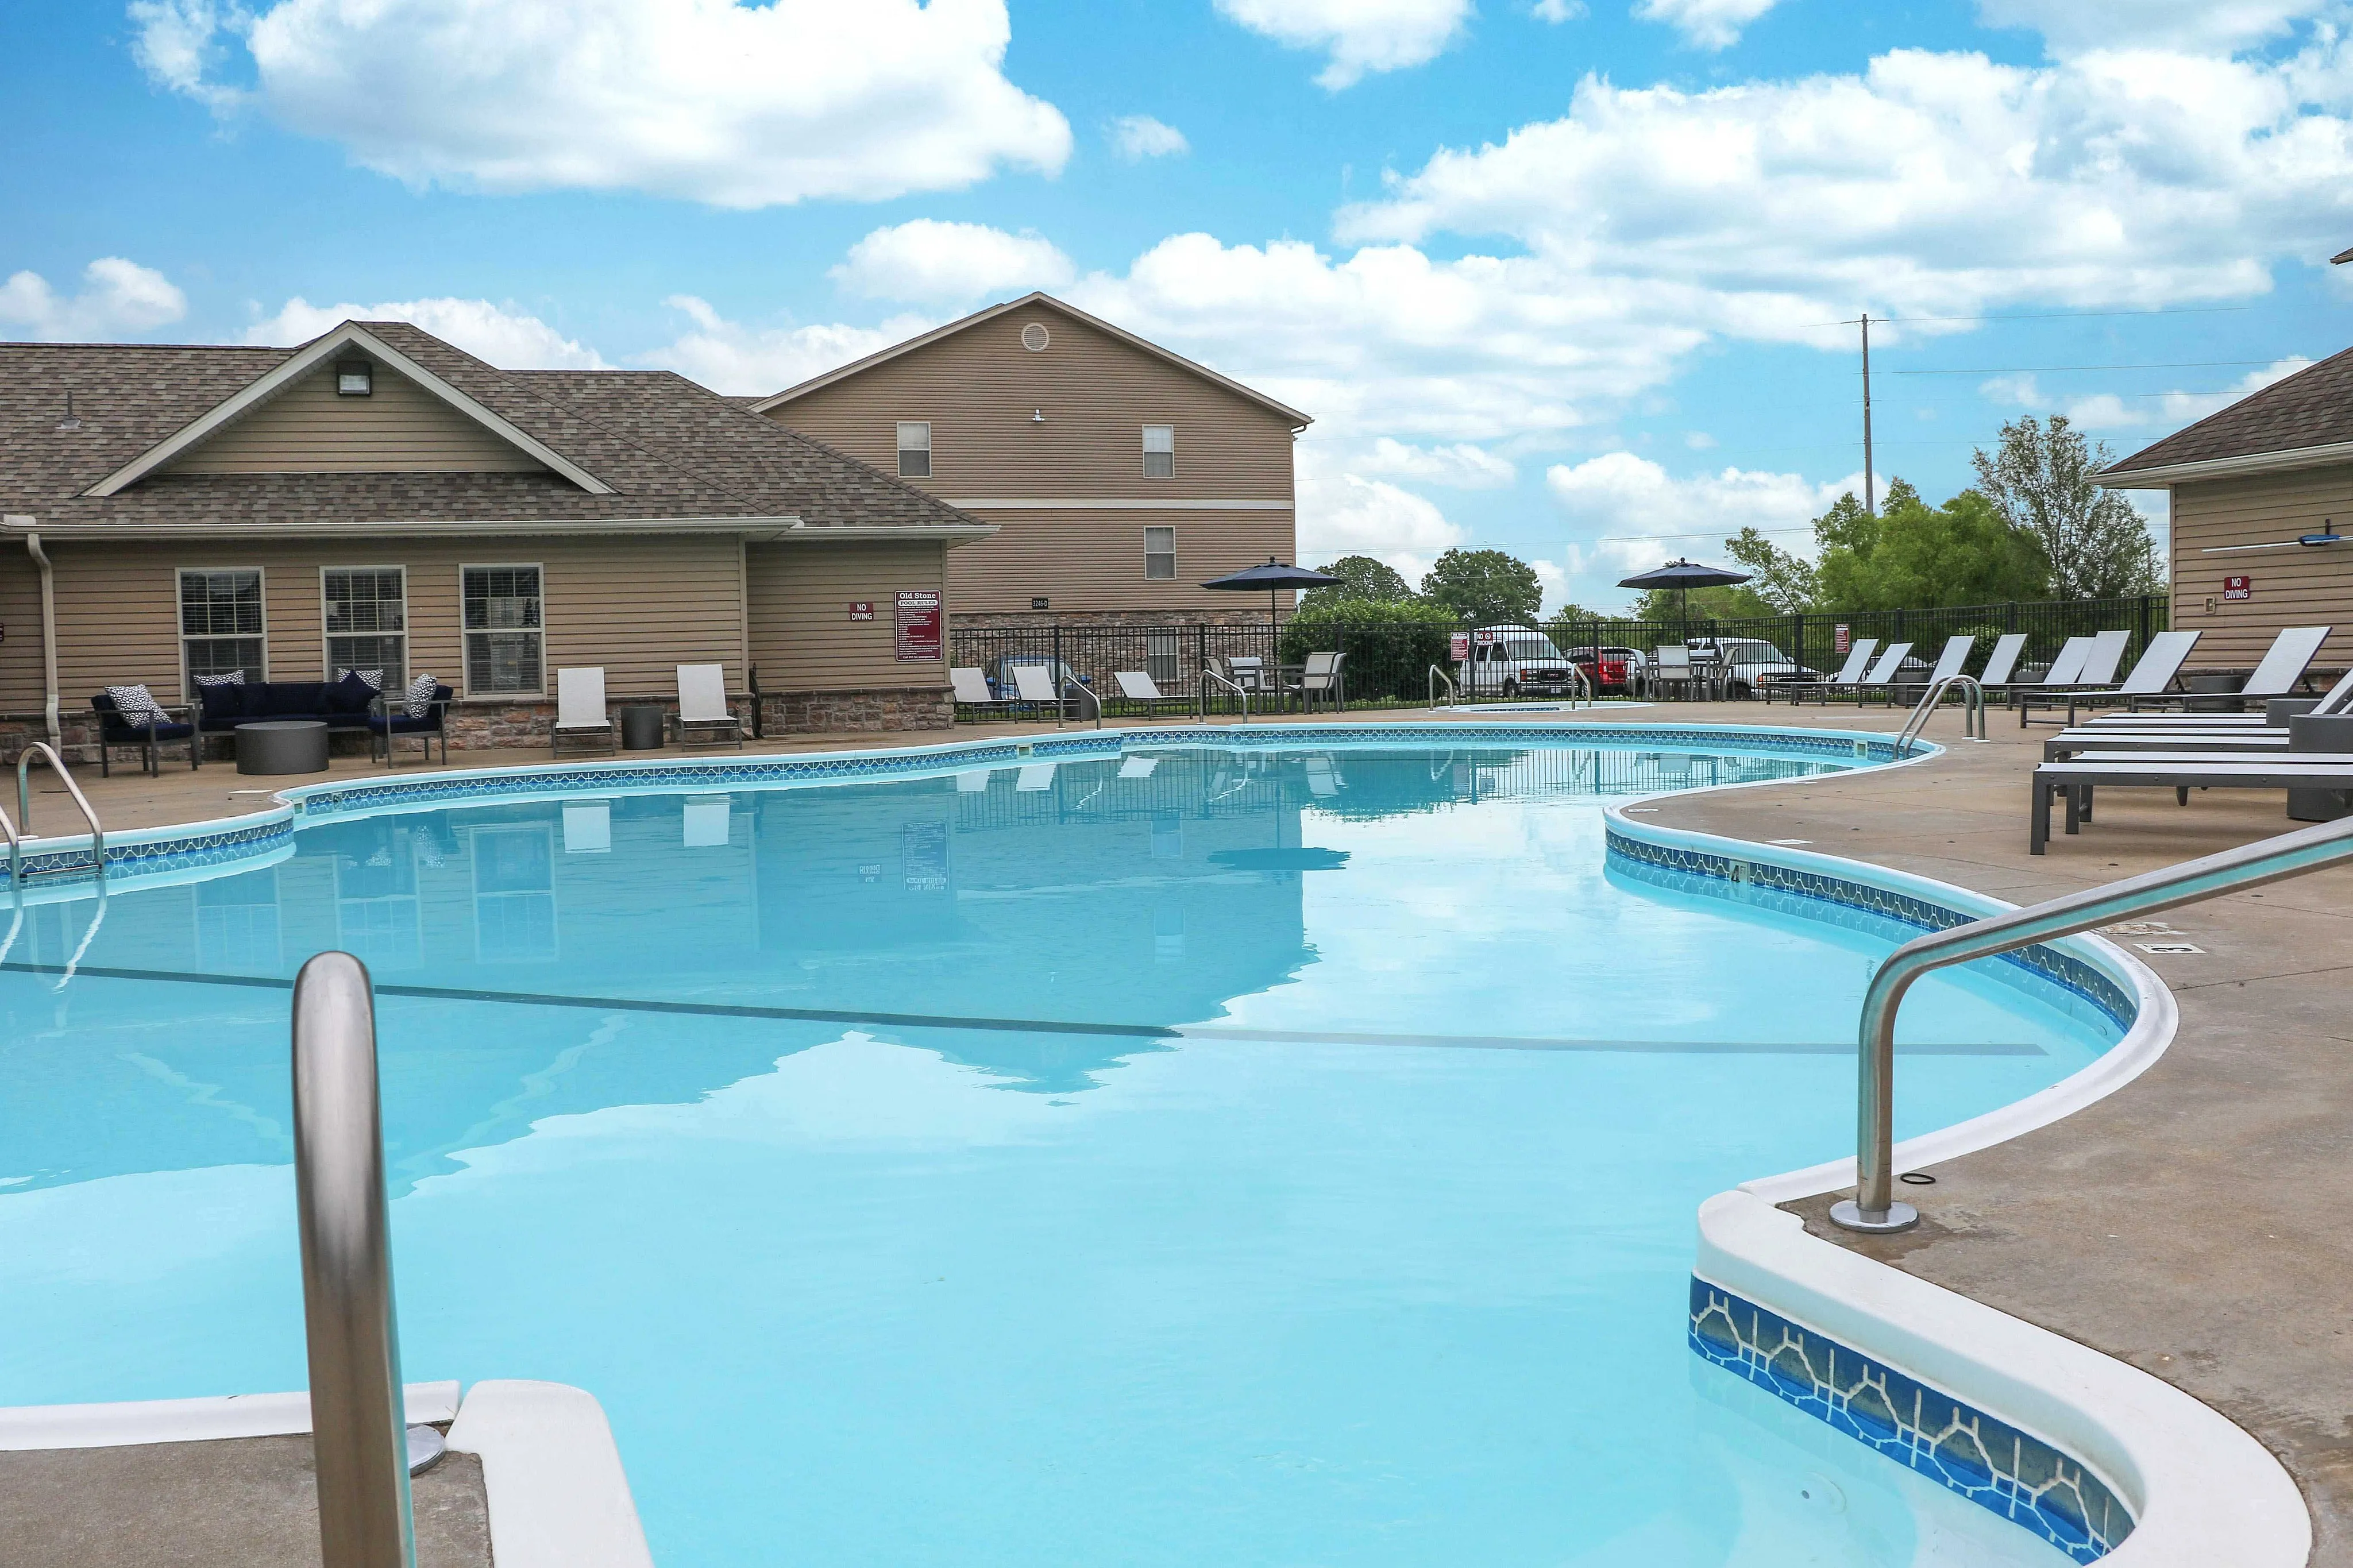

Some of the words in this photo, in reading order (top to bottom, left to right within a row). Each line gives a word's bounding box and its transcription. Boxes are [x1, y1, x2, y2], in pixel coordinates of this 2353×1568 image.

[2231, 577, 2242, 587] NO
[2225, 589, 2248, 599] DIVING
[851, 612, 873, 620] DIVING
[1731, 864, 1741, 883] 4
